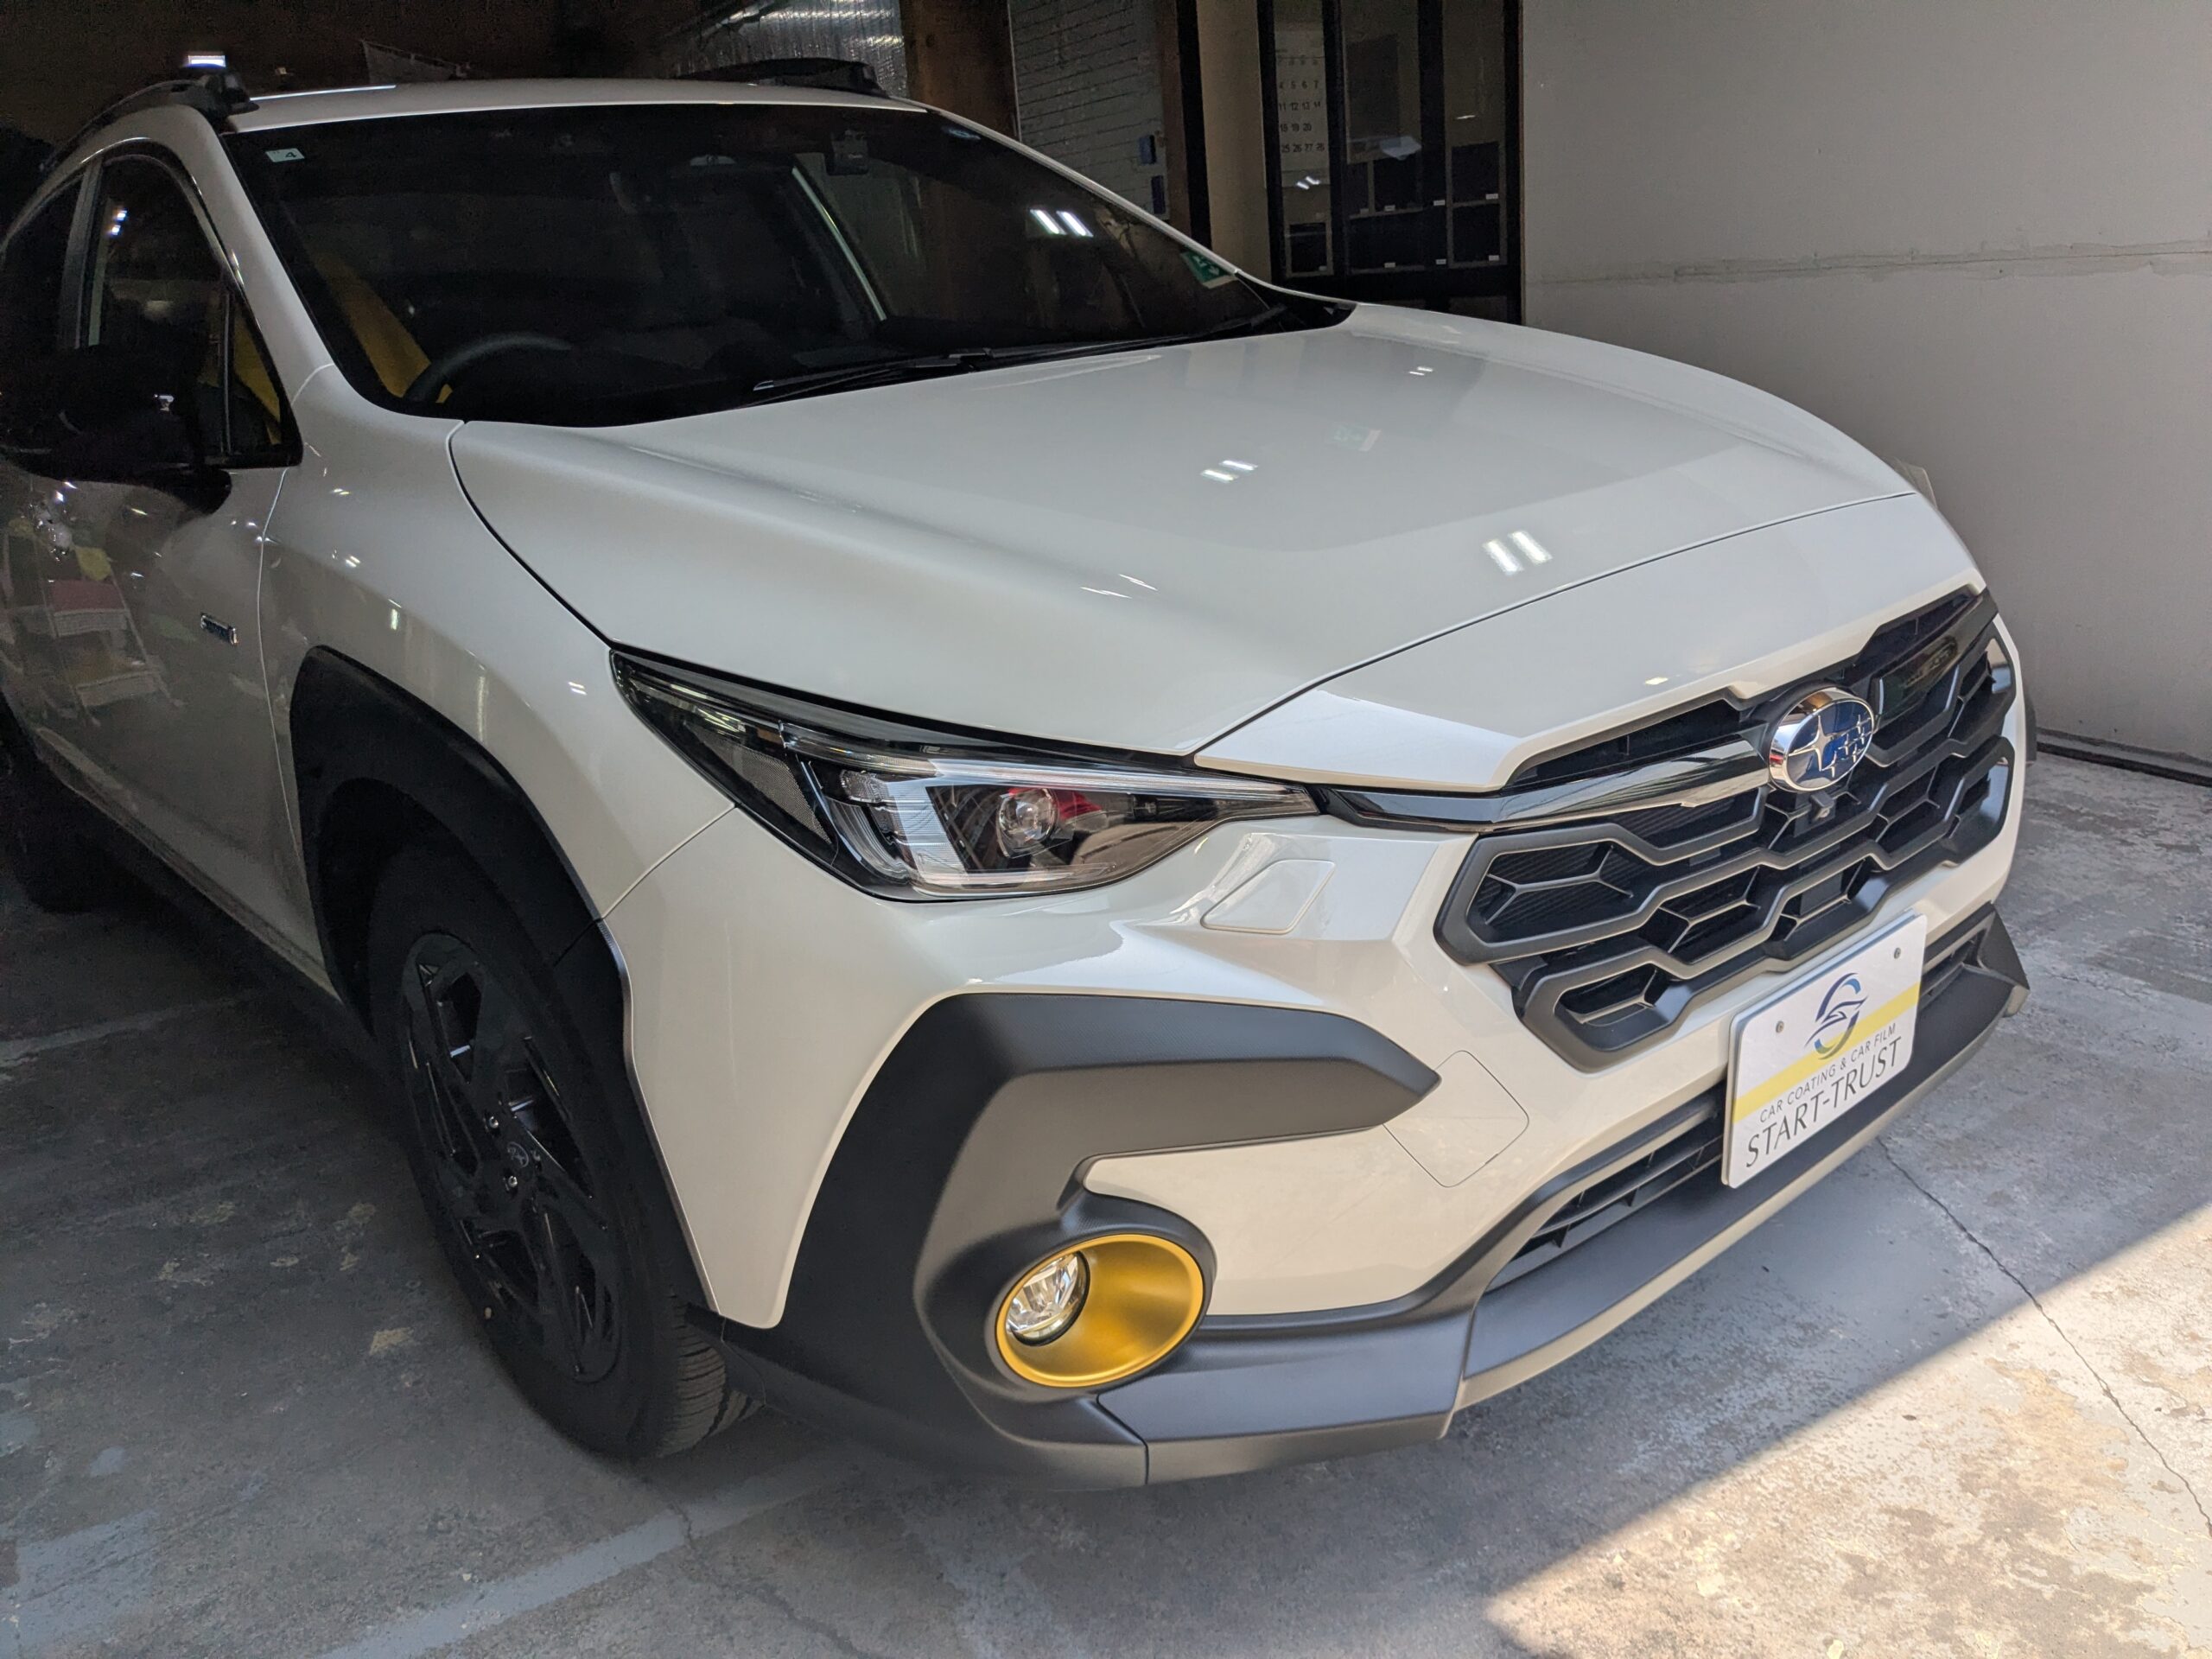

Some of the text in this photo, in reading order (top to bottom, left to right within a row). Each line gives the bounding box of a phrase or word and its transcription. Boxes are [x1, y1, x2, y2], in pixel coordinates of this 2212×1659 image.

[1745, 1036, 1902, 1167] START-TRUST
[1760, 1022, 1896, 1123] CAR COATING & CAR FILM
